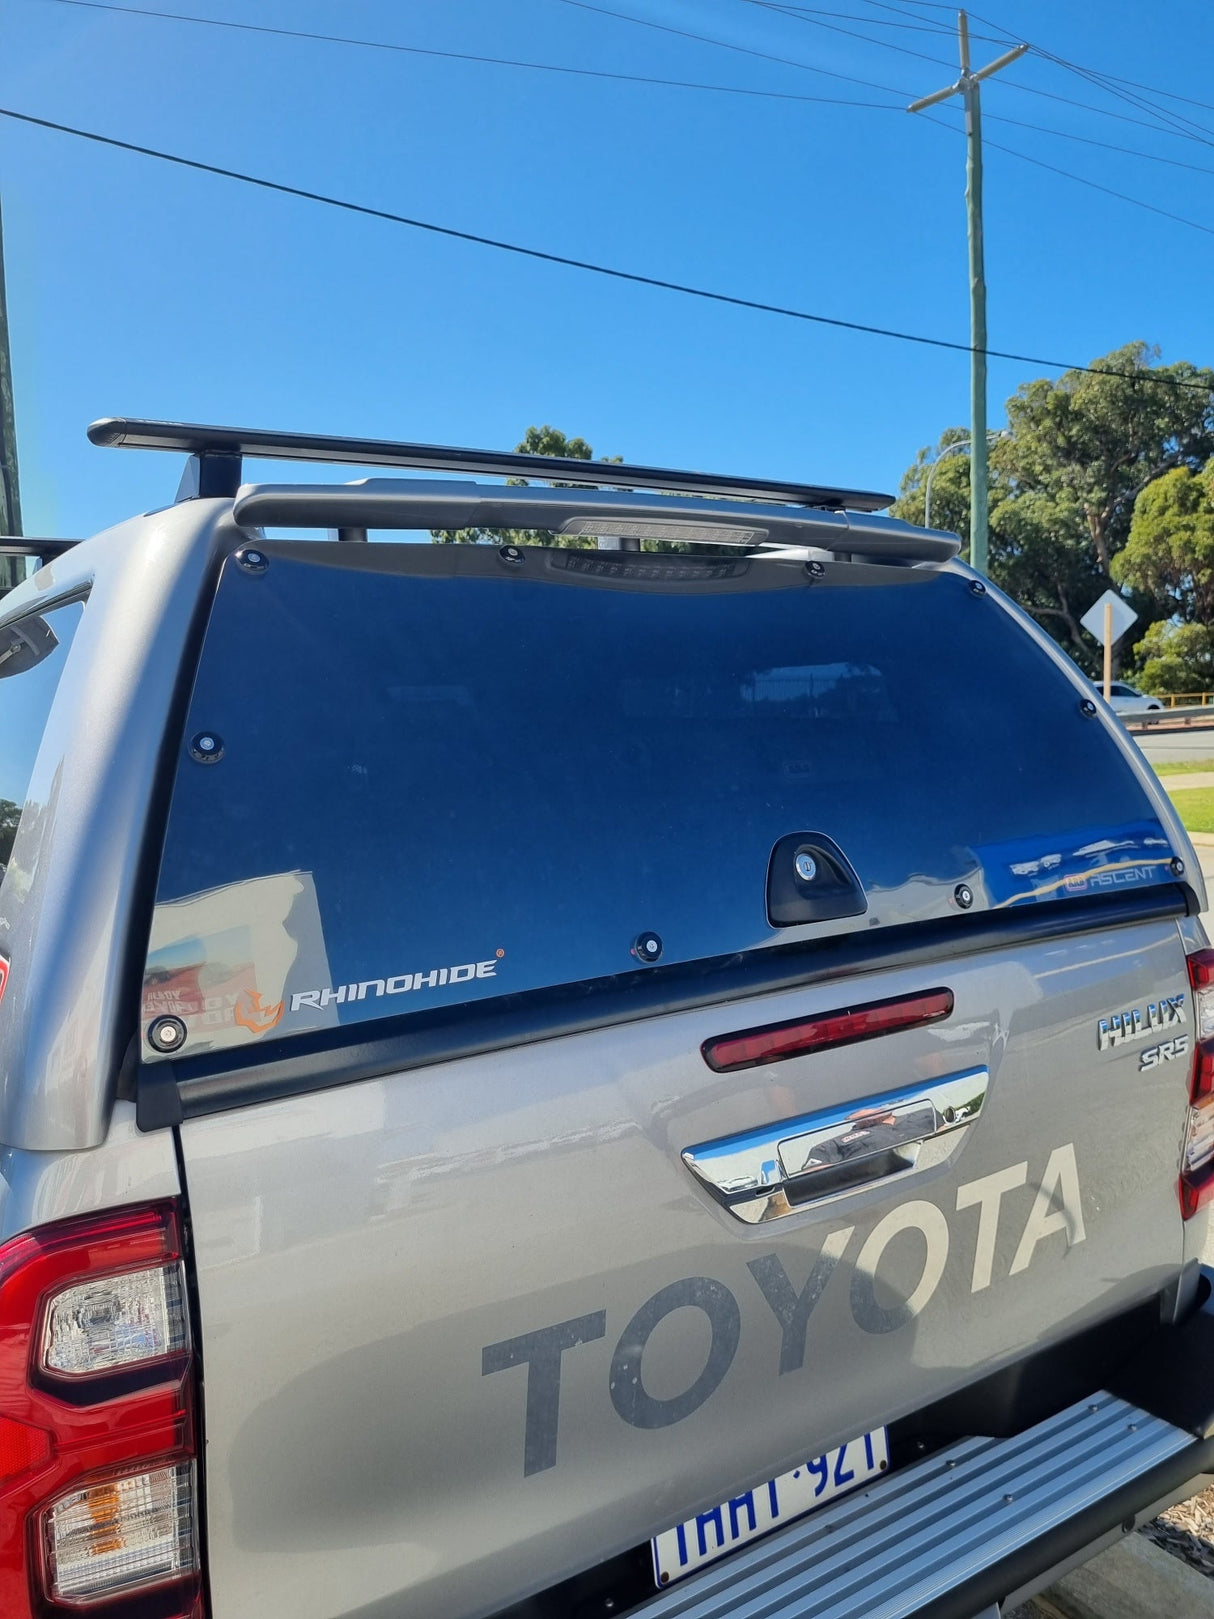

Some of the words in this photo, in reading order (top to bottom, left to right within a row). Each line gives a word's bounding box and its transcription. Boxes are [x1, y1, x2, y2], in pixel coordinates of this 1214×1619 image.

[1090, 866, 1157, 887] ASCENT
[290, 958, 498, 1011] RHINOHIDE
[1098, 993, 1187, 1051] HILUX
[1139, 1034, 1189, 1072] SR5
[481, 1142, 1087, 1478] TOYOTA
